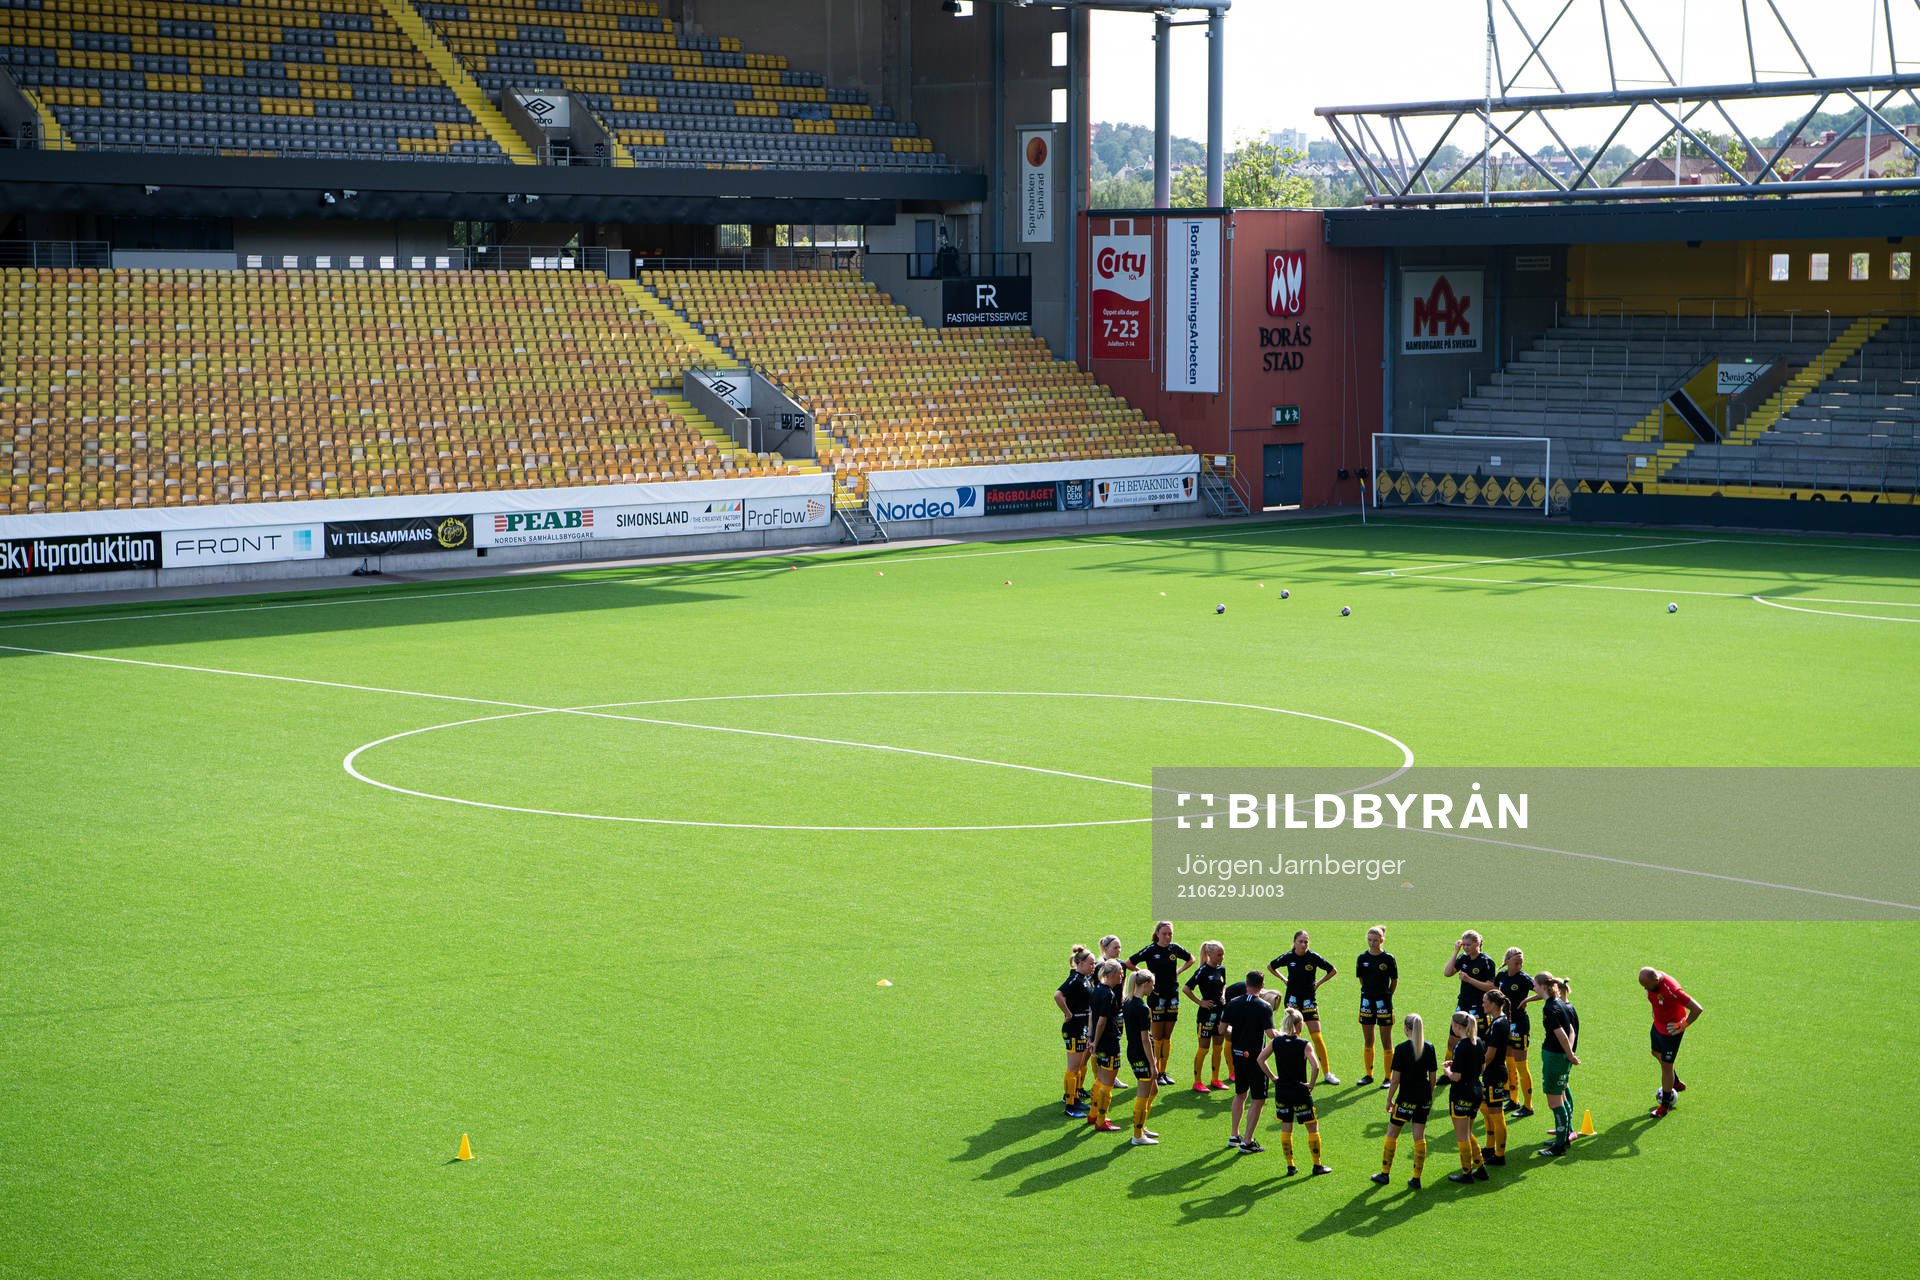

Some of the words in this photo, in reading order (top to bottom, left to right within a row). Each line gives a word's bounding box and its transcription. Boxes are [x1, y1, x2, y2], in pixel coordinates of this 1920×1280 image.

[1028, 173, 1036, 236] Sparbanken
[1190, 225, 1200, 264] Borås
[976, 284, 999, 309] FR
[1413, 274, 1471, 337] MAX
[946, 311, 1028, 323] FASTIGHETSSERVICE
[1188, 267, 1200, 385] MurningsArbeten
[1103, 319, 1139, 338] 7-23
[1259, 322, 1312, 347] BORÅS
[1263, 352, 1304, 371] STAD
[795, 416, 805, 428] P2
[1113, 481, 1126, 493] 7H
[1127, 478, 1179, 491] BEVAKNING
[986, 488, 1055, 504] FÄRGBOLAGET
[748, 508, 806, 527] ProFlow
[876, 498, 955, 521] Nordea
[505, 510, 583, 532] PEAB
[616, 511, 689, 528] SIMONSLAND
[175, 534, 282, 556] FRONT
[331, 533, 343, 546] VI
[346, 528, 433, 545] TILLSAMMANS
[494, 535, 527, 544] NORDENS
